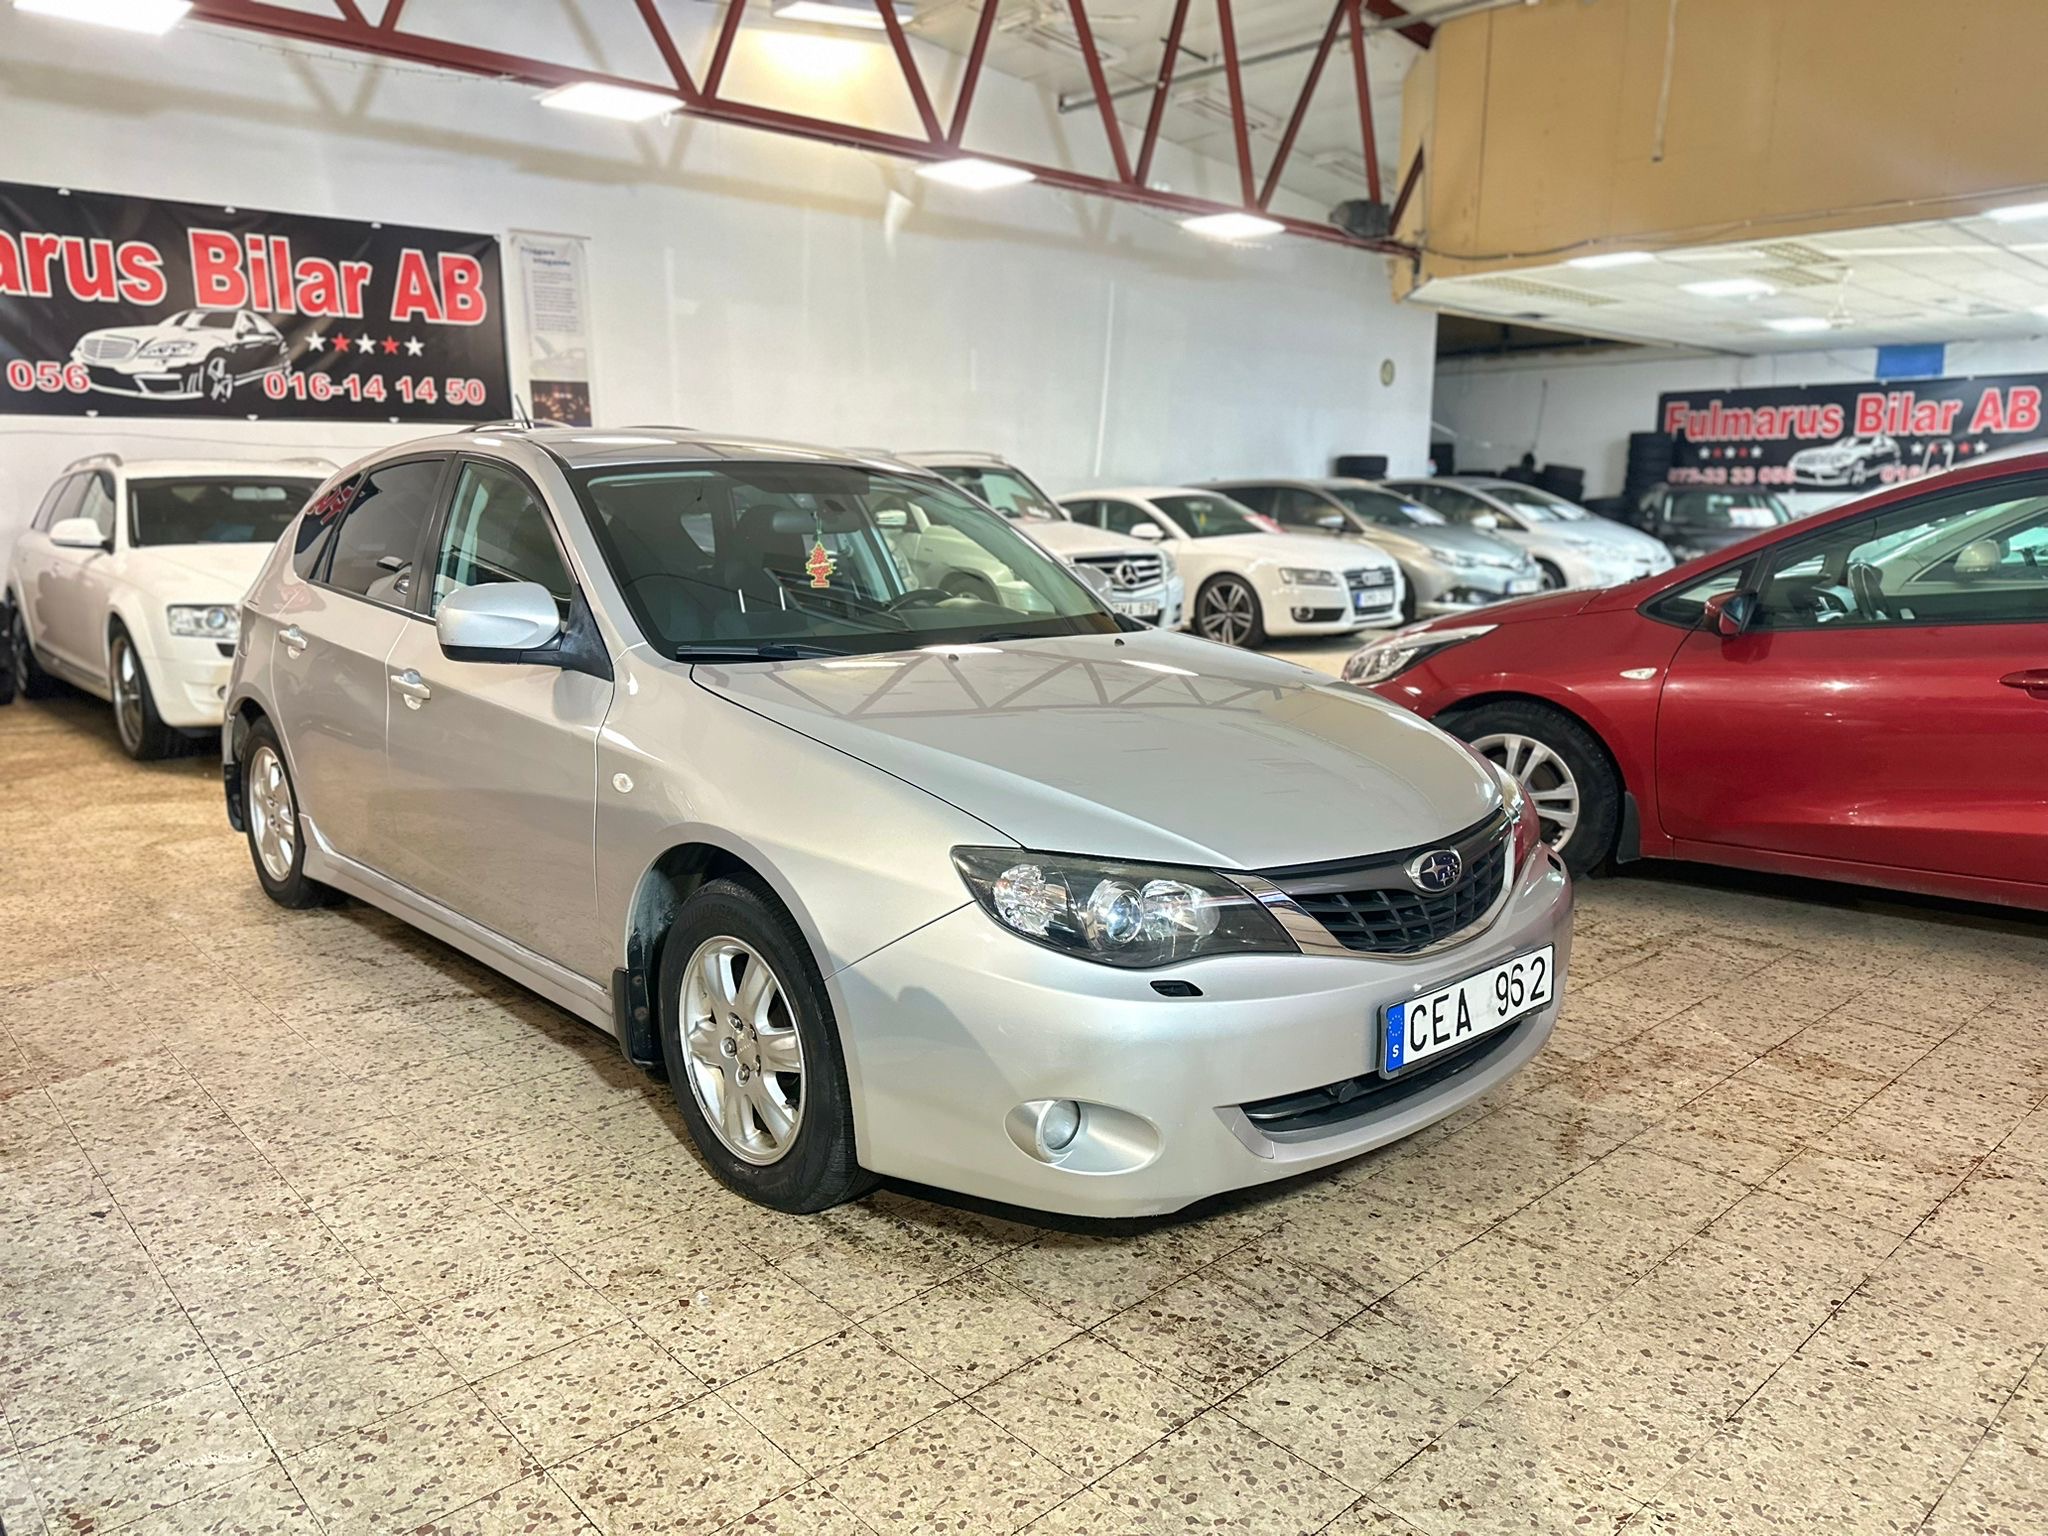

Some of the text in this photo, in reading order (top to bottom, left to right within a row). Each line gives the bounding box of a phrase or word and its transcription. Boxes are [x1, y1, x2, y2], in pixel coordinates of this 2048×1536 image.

[187, 228, 373, 319] Bilar
[390, 248, 487, 326] AB
[6, 359, 486, 406] 056 016-14 14 50
[1664, 386, 2042, 443] Fulmarus Bilar AB
[1392, 956, 1546, 1058] S CEA 962
